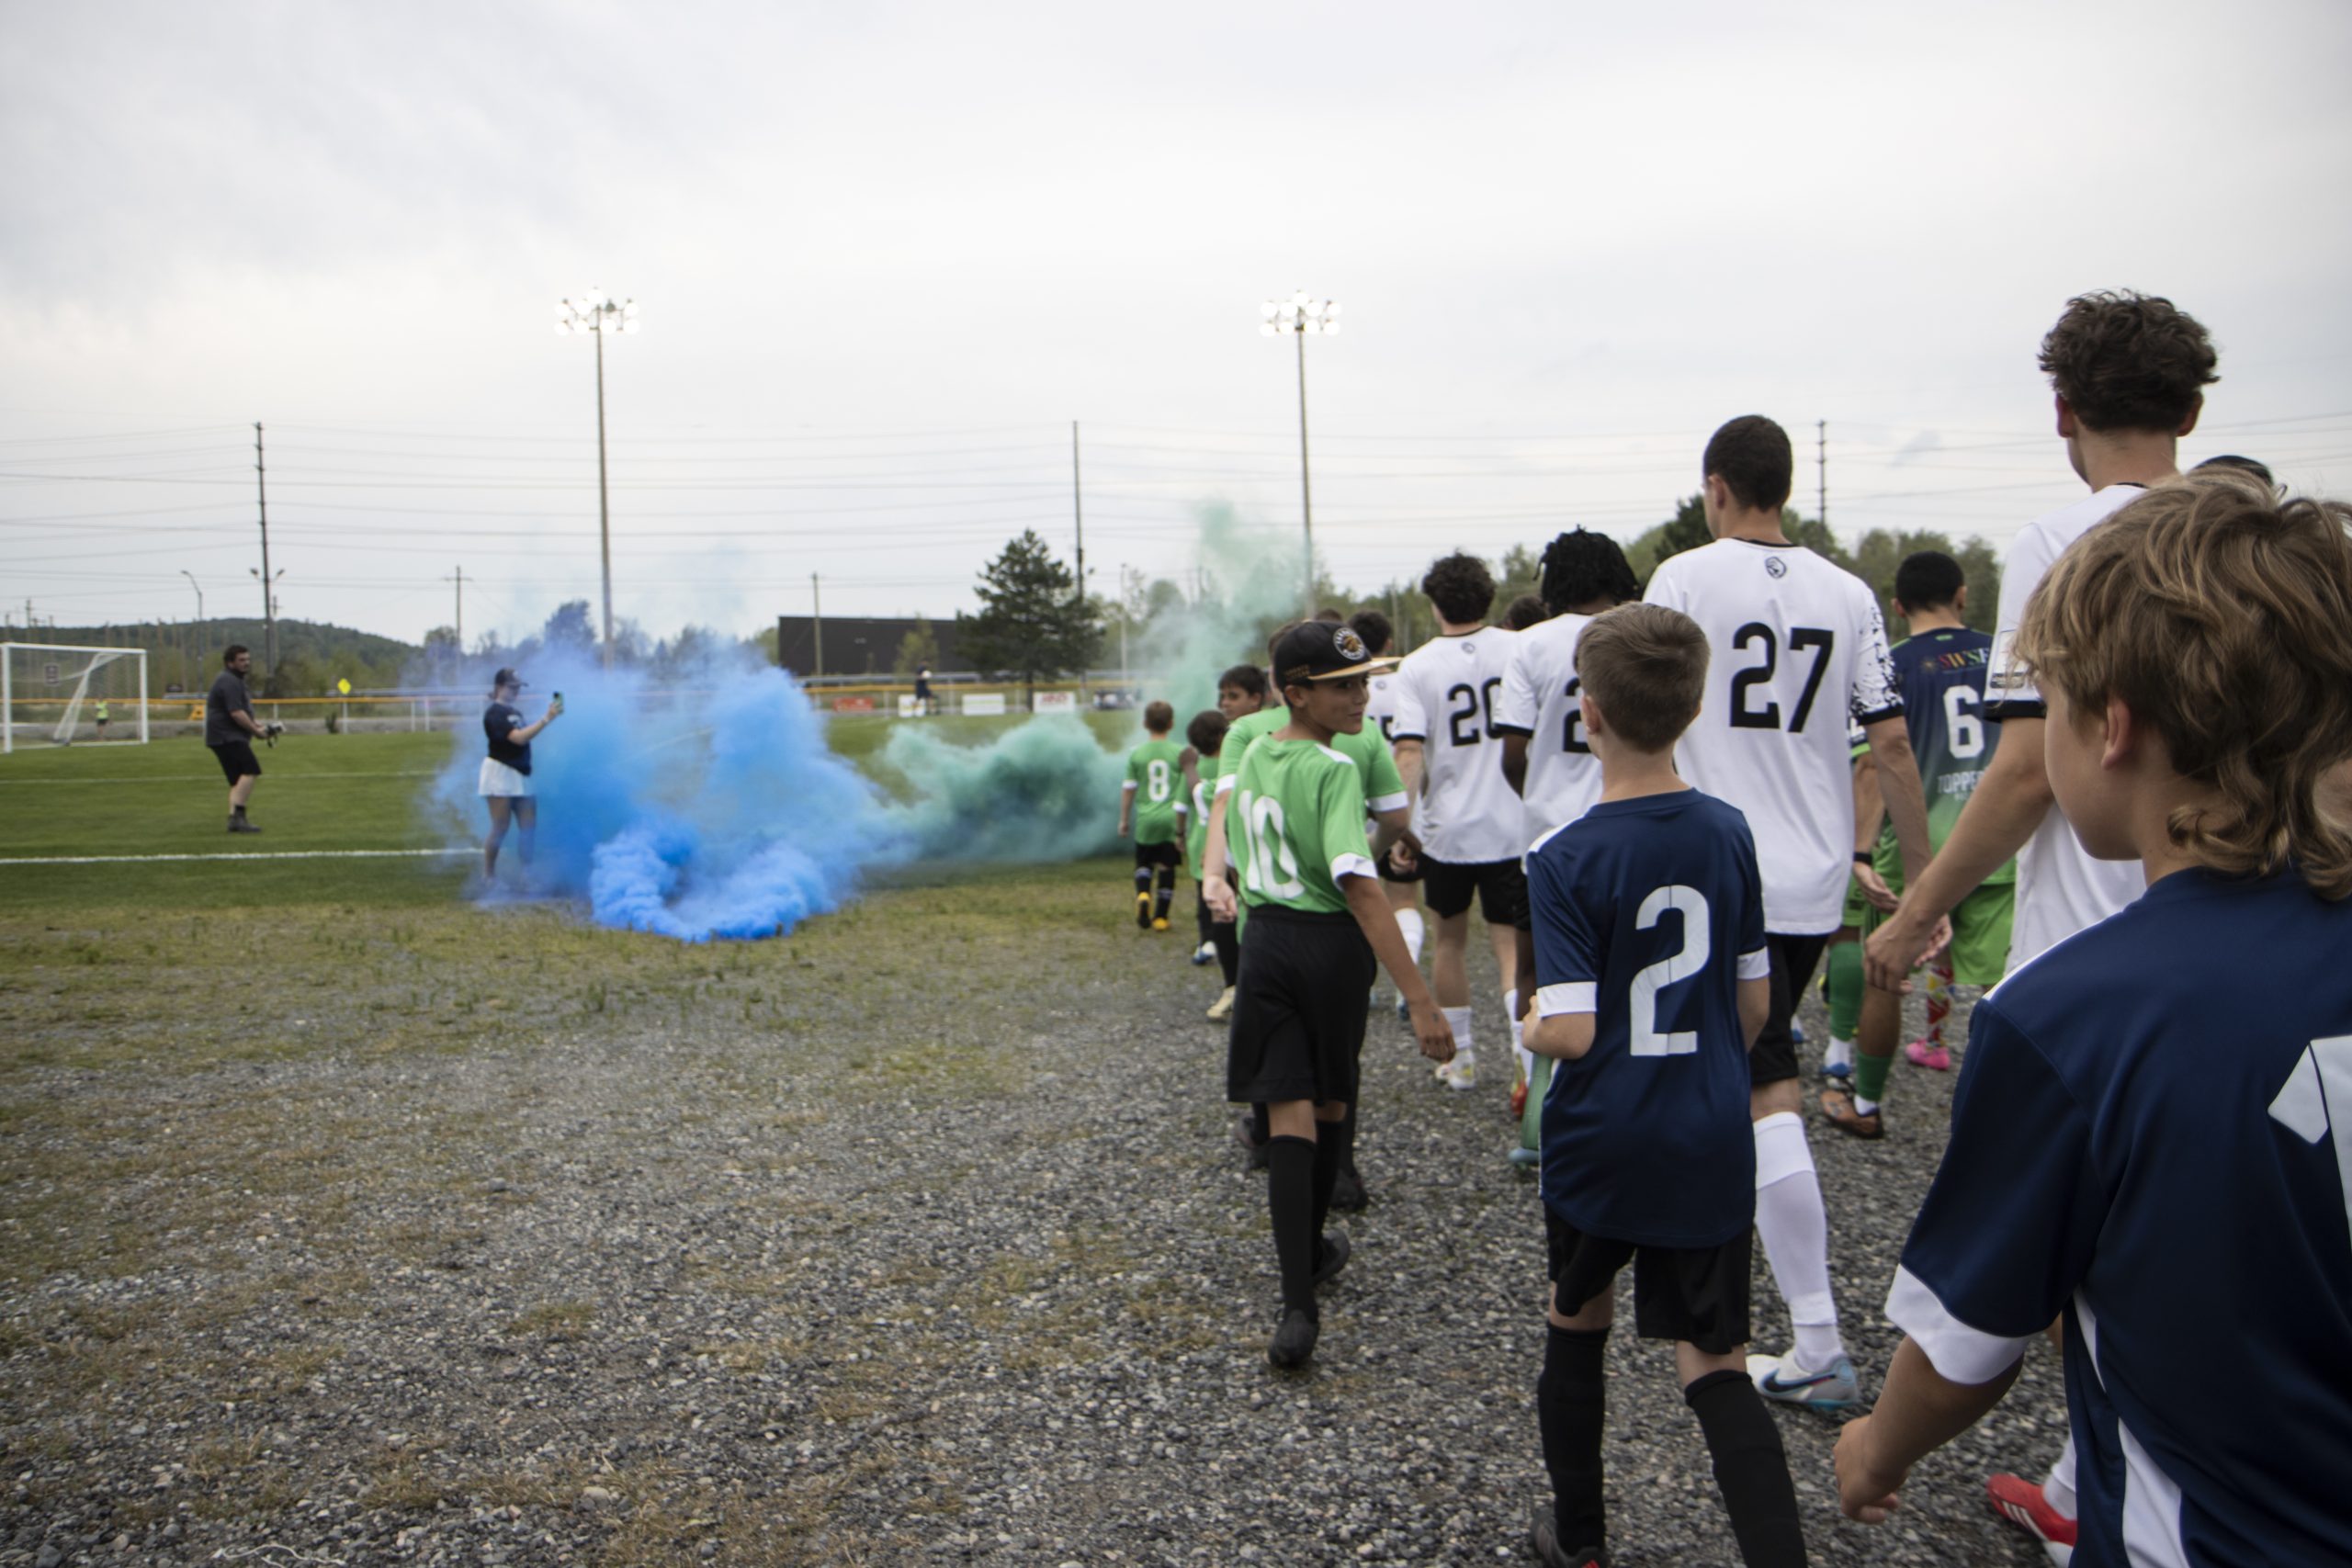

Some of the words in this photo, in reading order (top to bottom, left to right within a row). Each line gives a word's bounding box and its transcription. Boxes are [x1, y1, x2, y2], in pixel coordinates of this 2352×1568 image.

[1730, 621, 1834, 734] 27
[1942, 684, 1985, 759] 6
[1147, 759, 1170, 801] 8
[1238, 789, 1306, 898] 10
[1630, 885, 1711, 1057] 2
